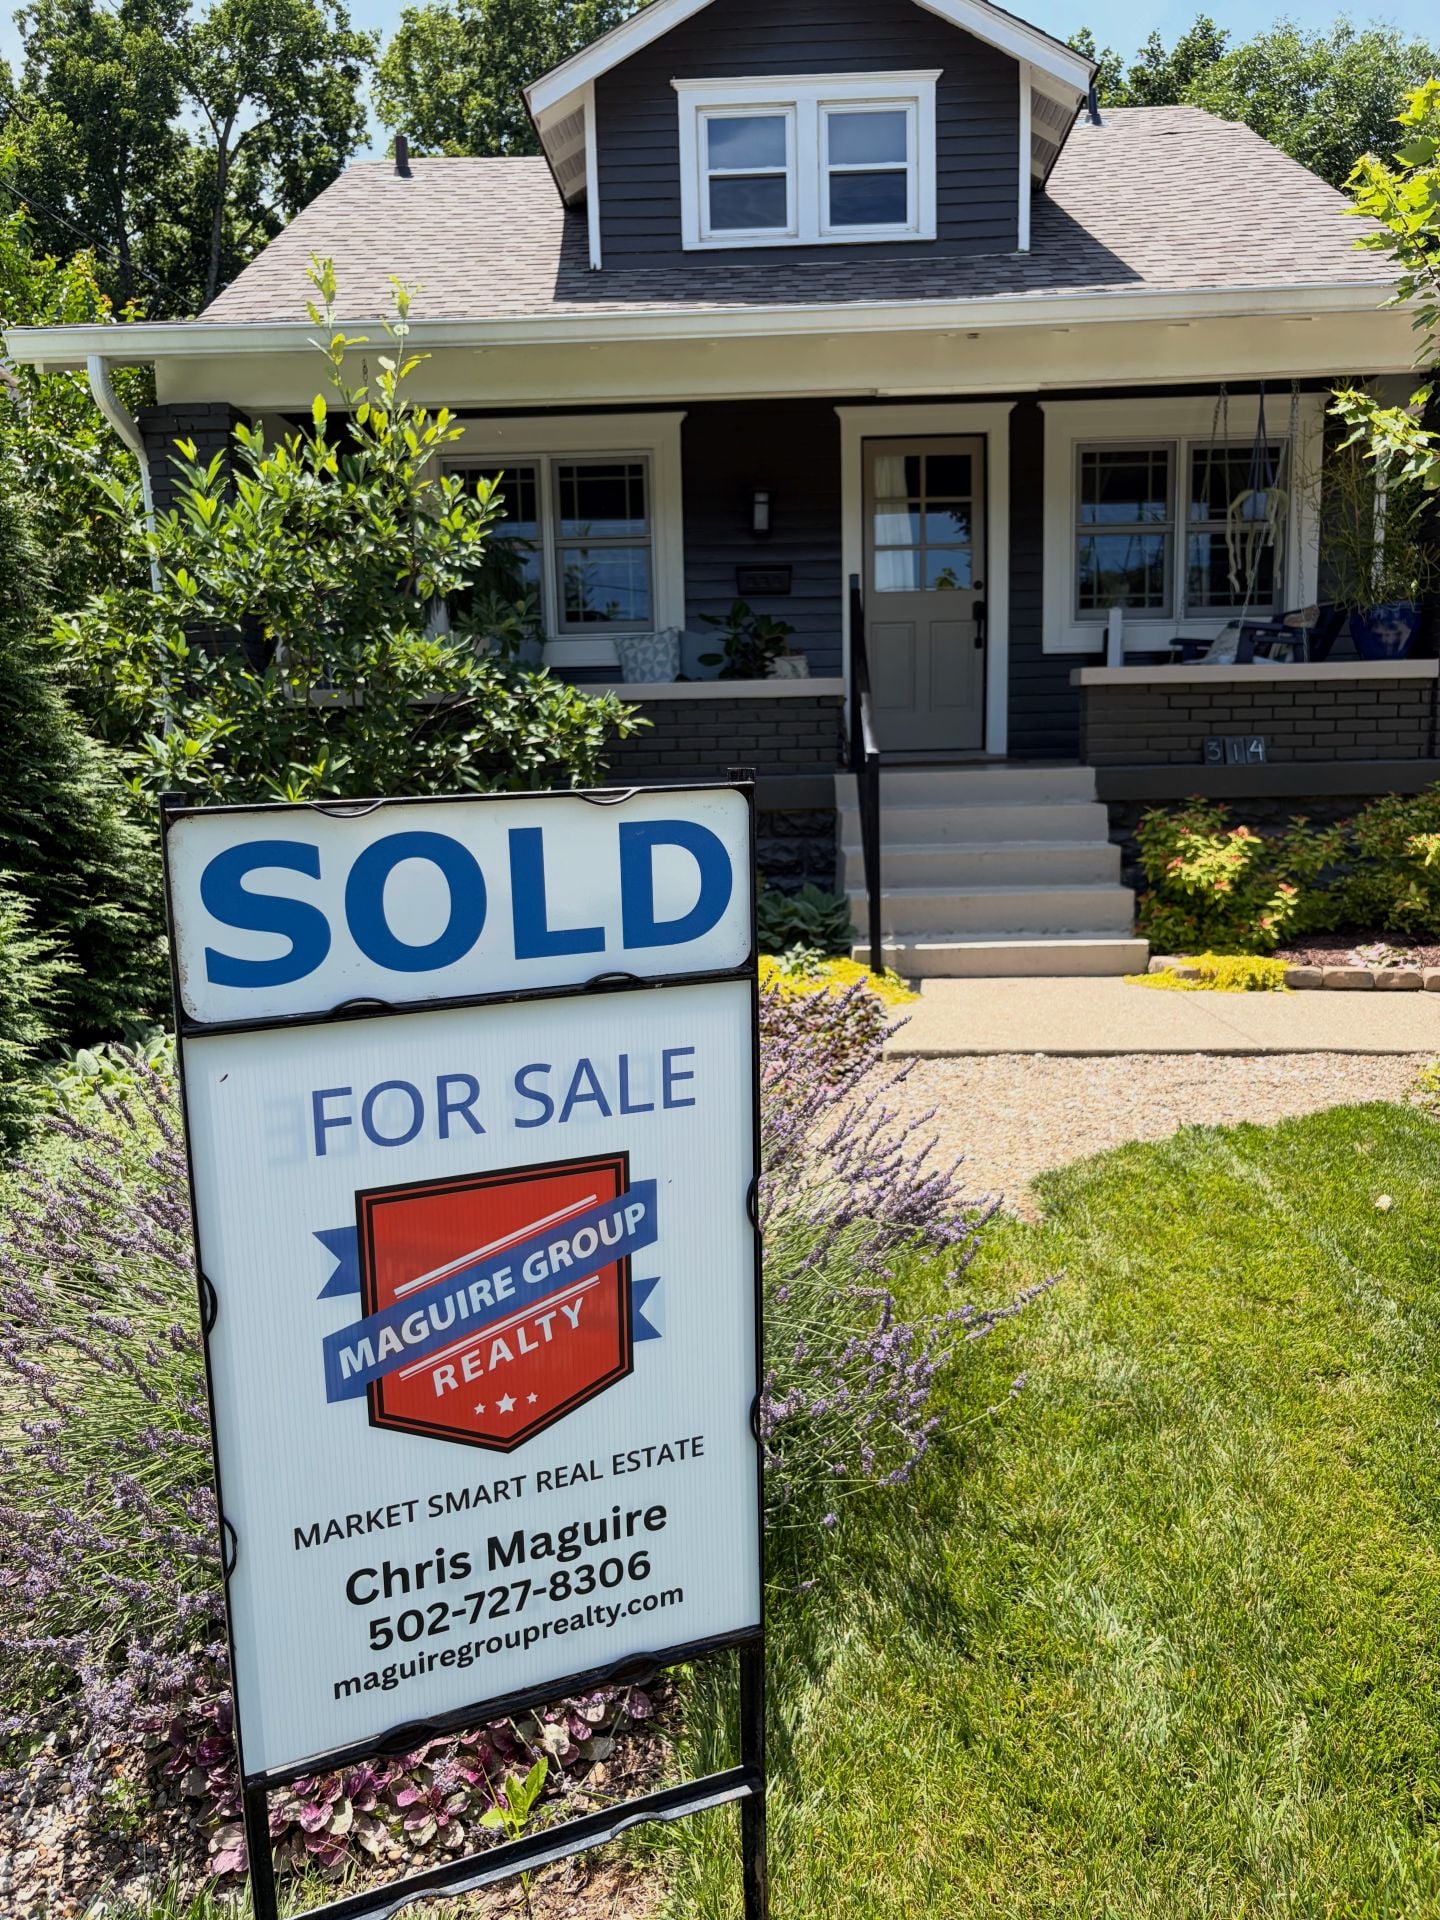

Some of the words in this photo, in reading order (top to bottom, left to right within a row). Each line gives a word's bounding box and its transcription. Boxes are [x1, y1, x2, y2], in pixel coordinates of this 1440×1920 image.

[1207, 739, 1264, 761] 314
[200, 819, 733, 988] SOLD
[312, 1073, 486, 1156] FOR
[514, 1046, 696, 1129] SALE
[338, 1266, 516, 1380] MAGUIRE
[522, 1202, 646, 1284] GROUP
[432, 1297, 584, 1397] REALTY
[293, 1500, 419, 1550] MARKET
[428, 1475, 527, 1518] SMART
[536, 1460, 604, 1493] REAL
[612, 1435, 705, 1476] ESTATE
[345, 1547, 471, 1606] Chris
[487, 1504, 668, 1571] Maguire
[369, 1550, 651, 1651] 502-727-8306
[333, 1587, 684, 1699] maguiregrouprealty.com
